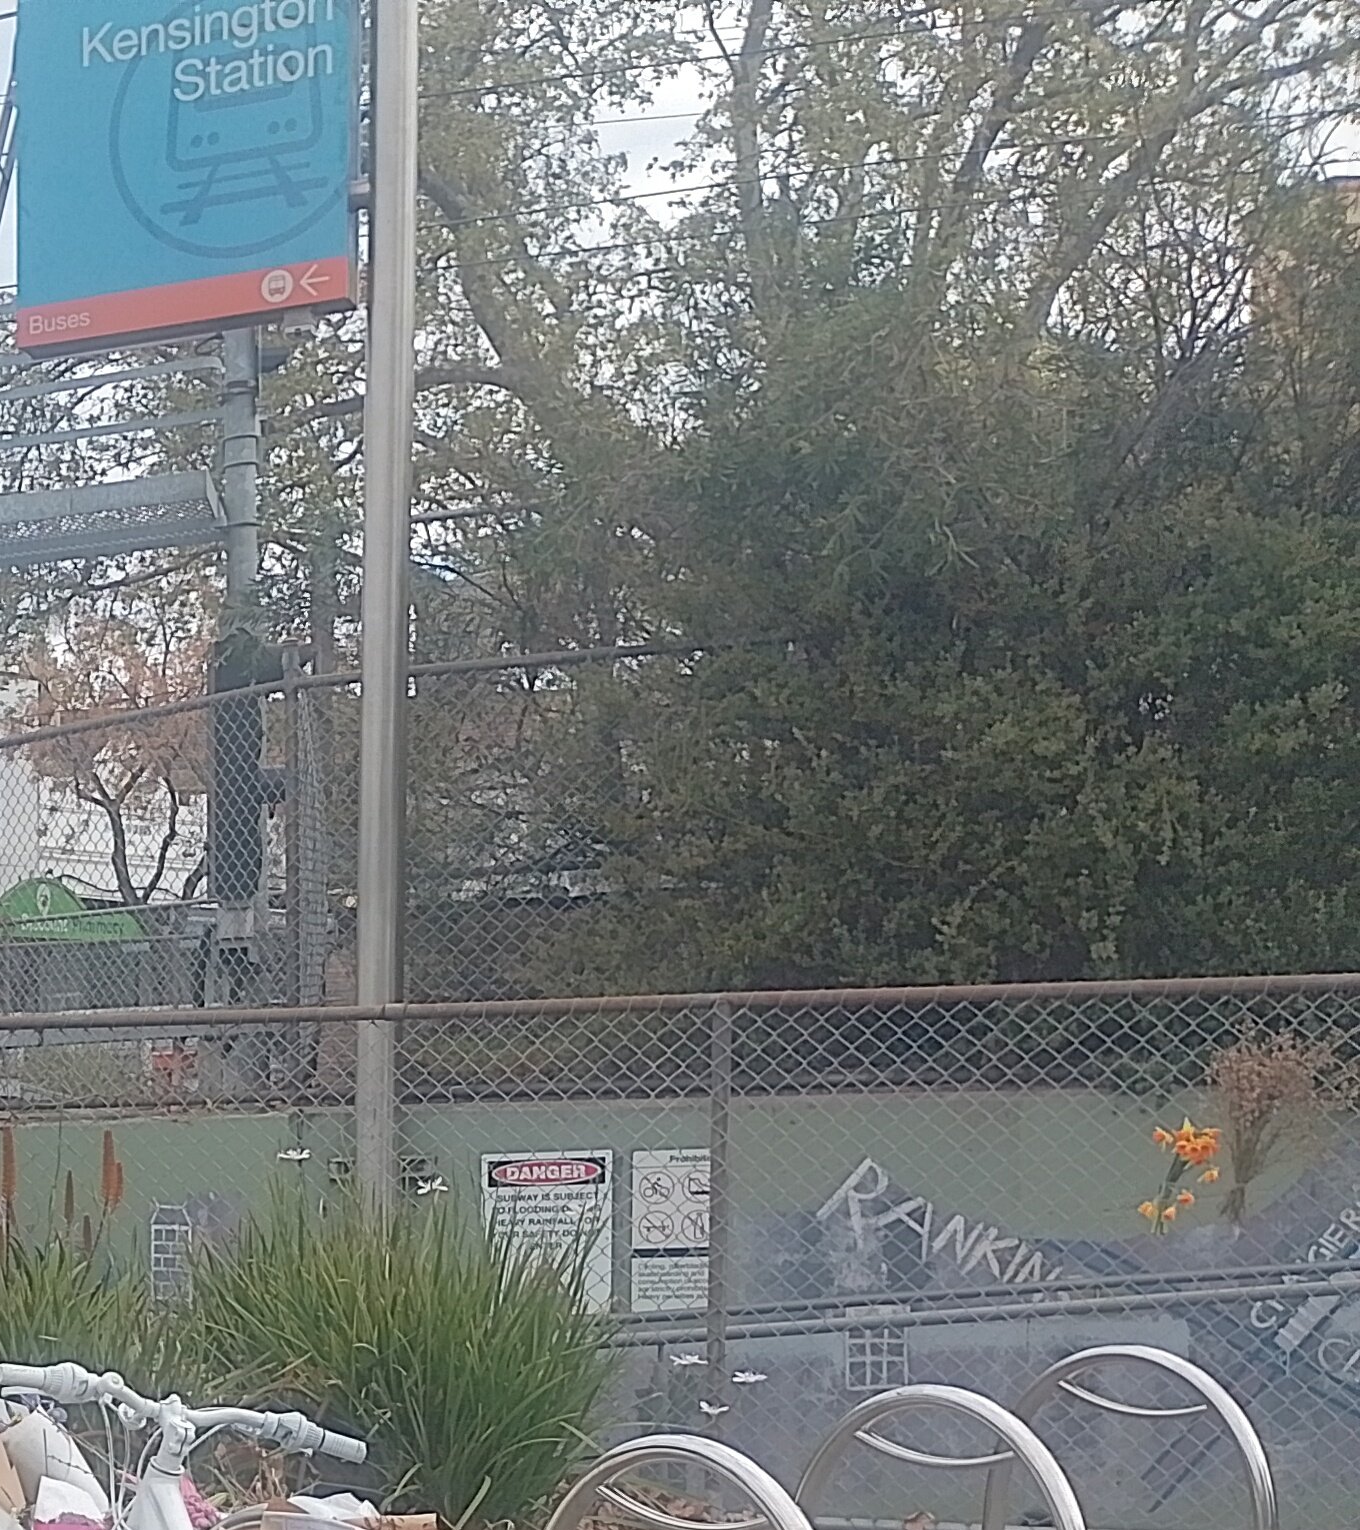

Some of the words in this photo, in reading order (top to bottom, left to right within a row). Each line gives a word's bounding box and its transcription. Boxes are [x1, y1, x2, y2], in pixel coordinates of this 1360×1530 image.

[82, 0, 334, 67] Kensington
[173, 43, 333, 102] Station
[28, 312, 91, 335] Buses
[506, 1165, 586, 1180] DANGER
